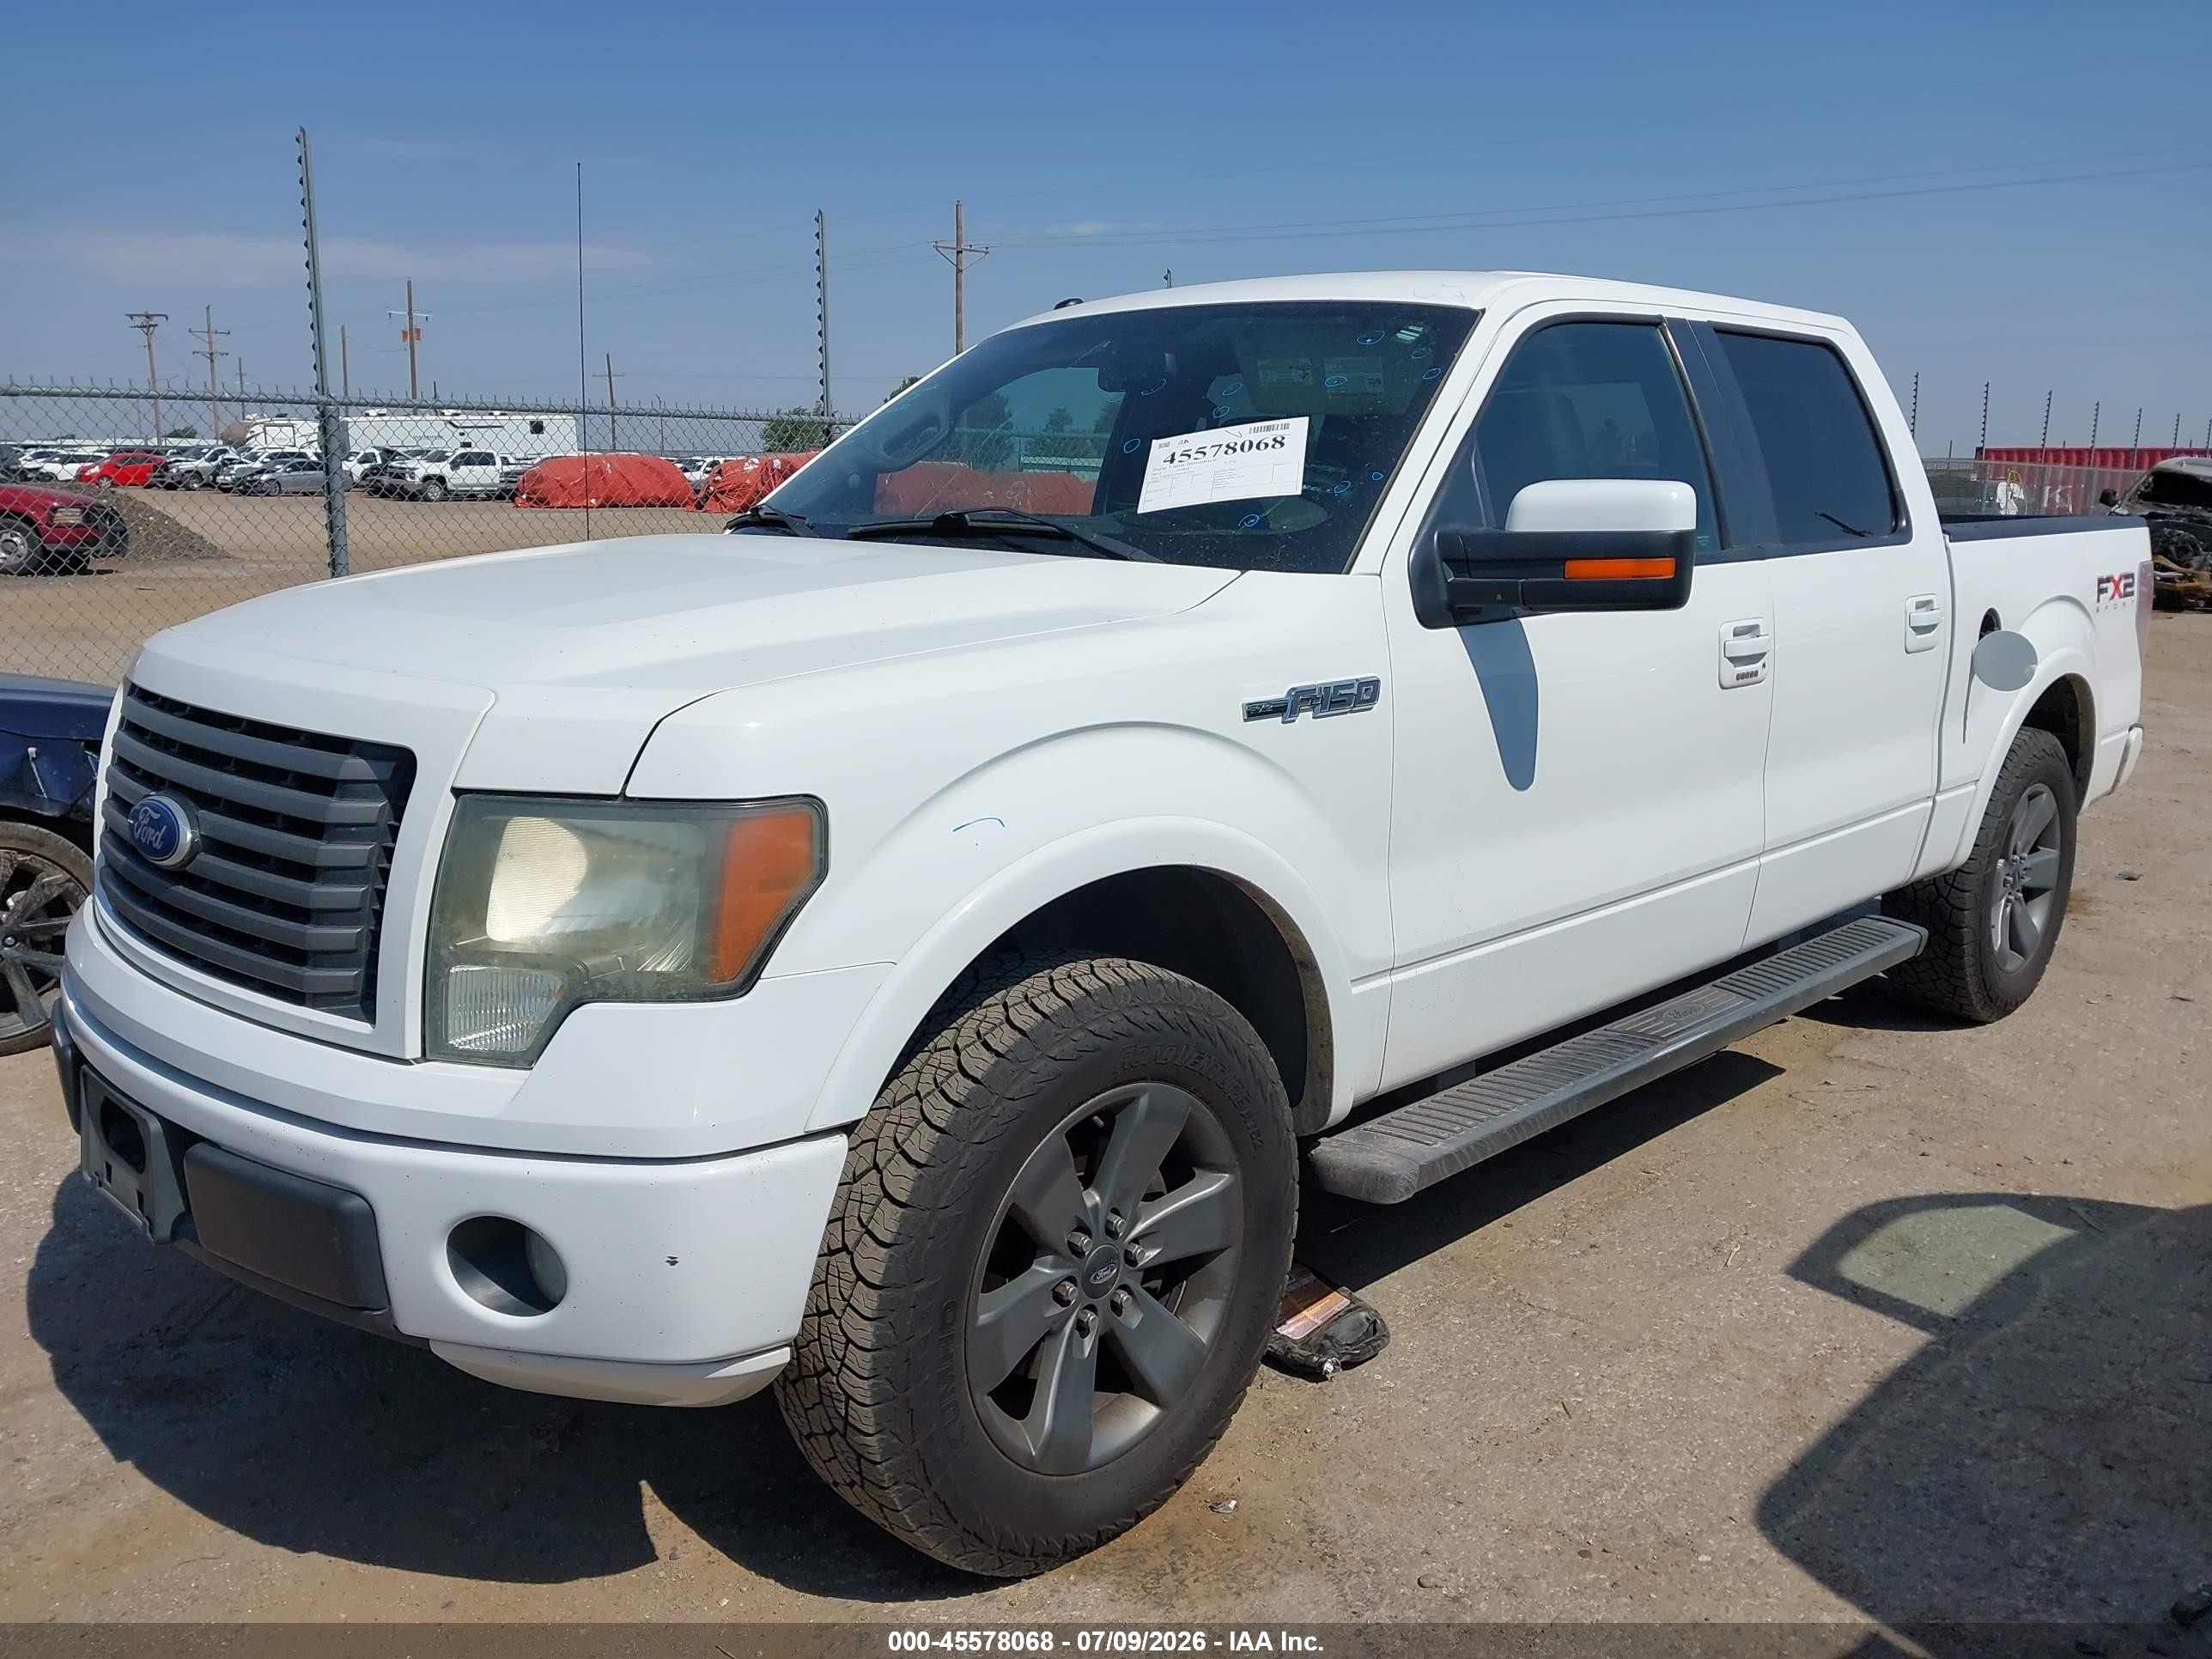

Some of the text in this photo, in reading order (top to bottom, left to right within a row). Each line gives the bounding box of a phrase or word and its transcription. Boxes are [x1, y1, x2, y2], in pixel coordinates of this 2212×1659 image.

[1162, 435, 1286, 465] 45578068
[2097, 573, 2135, 603] FX2
[1281, 675, 1381, 724] F-150
[133, 805, 167, 850] Ford
